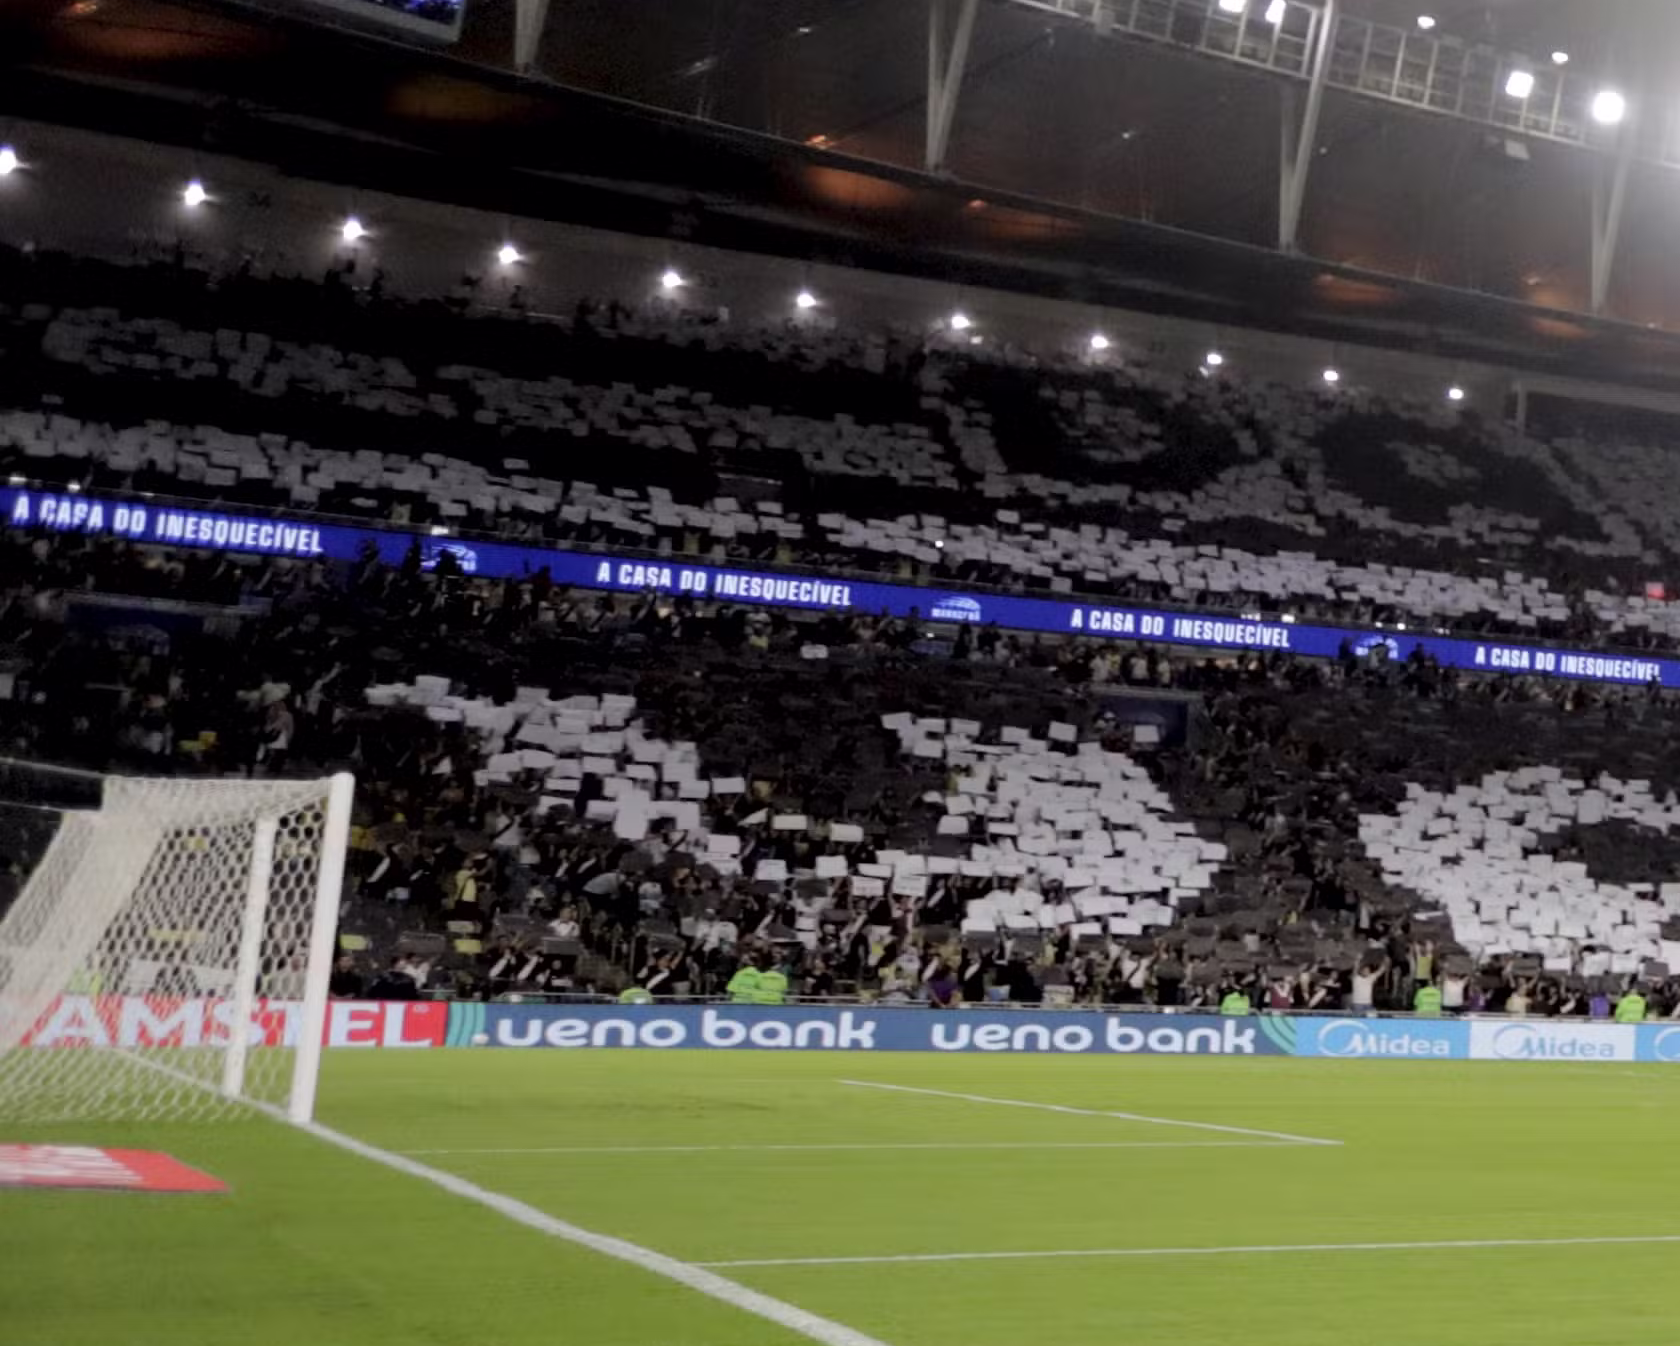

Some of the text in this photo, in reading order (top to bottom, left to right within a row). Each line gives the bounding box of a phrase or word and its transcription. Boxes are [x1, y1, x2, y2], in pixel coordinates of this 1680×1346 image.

[14, 493, 29, 524] A
[113, 506, 147, 532] DO
[155, 513, 323, 554] INESQUECÍVEL
[597, 562, 851, 607] A CASA DO INESQUECÍVEL
[1071, 609, 1290, 648] A CASA DO INESQUECÍVEL
[1475, 646, 1485, 664] A
[1490, 647, 1530, 668] CASA
[1534, 651, 1554, 671] DO
[33, 996, 434, 1048] AMSTEL
[498, 1010, 877, 1049] ueno bank
[930, 1017, 1255, 1053] ueno bank
[1335, 1027, 1450, 1057] Midea
[1508, 1029, 1615, 1060] Midea
